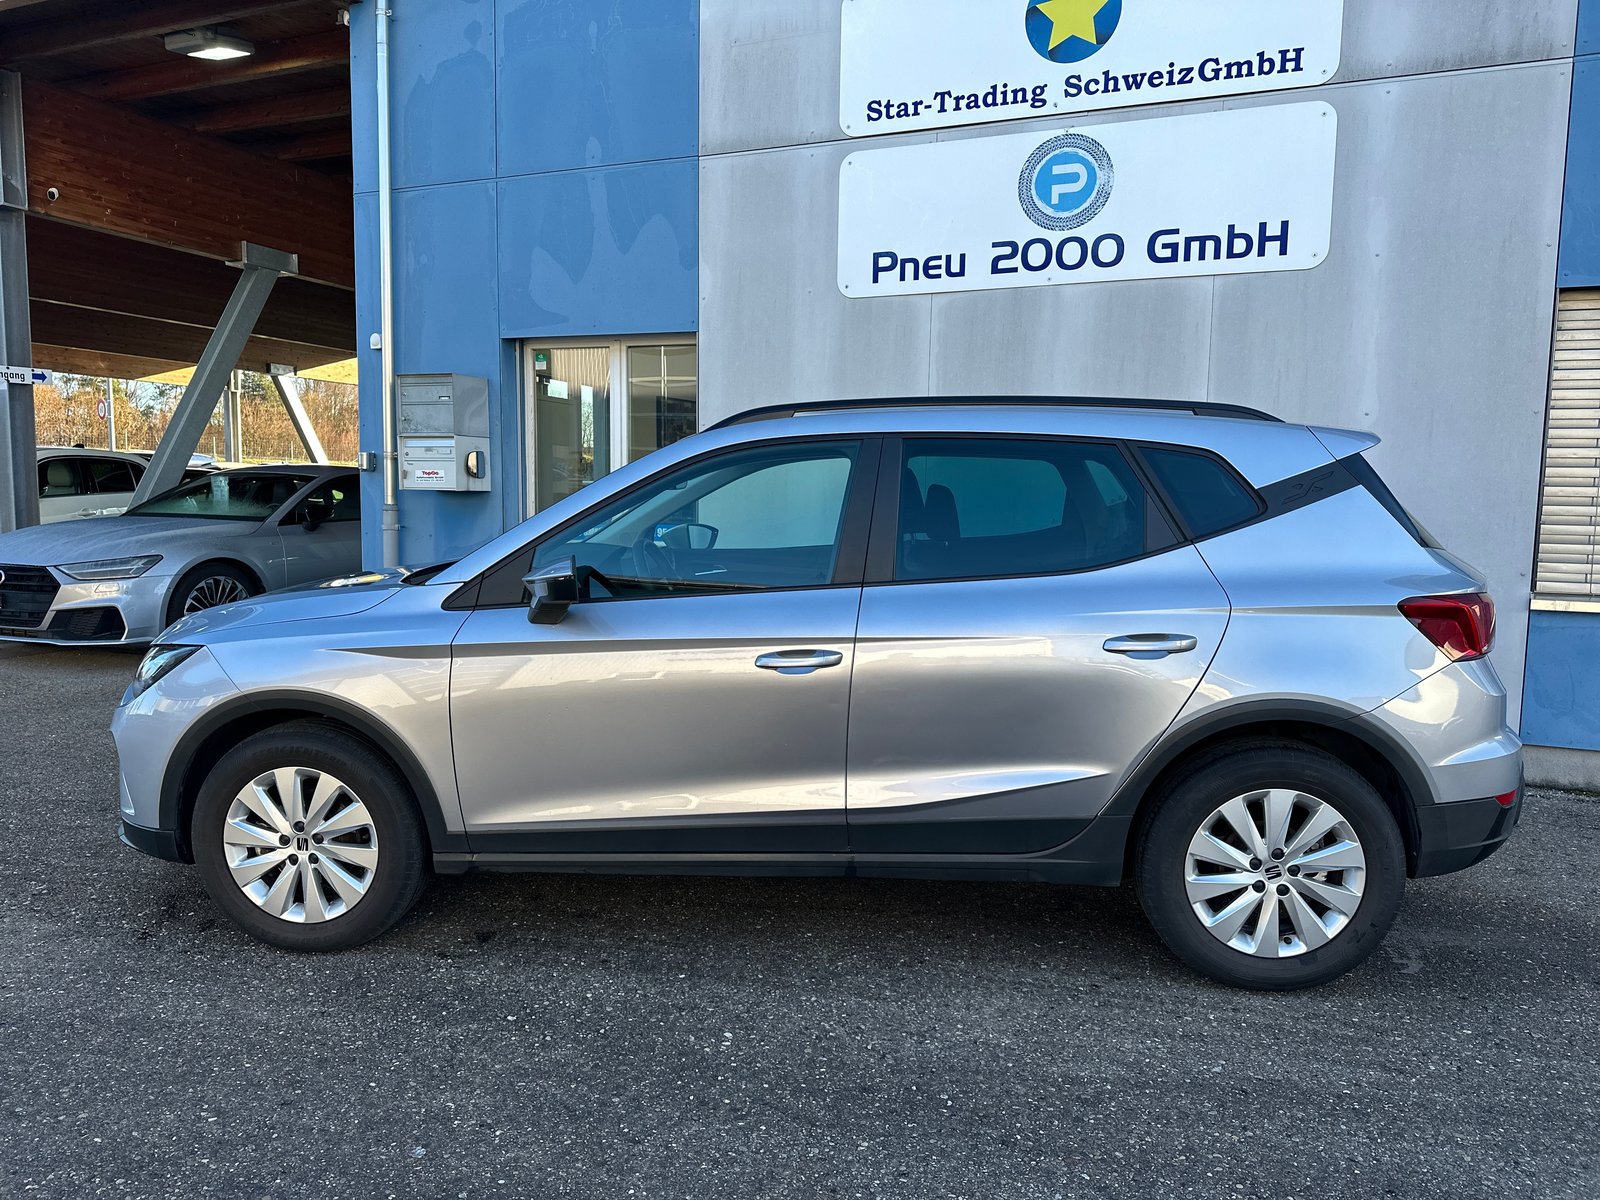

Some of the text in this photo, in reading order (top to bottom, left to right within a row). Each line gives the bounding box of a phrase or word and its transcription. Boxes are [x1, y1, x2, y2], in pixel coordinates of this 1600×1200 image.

[866, 82, 1048, 123] Star-Trading
[872, 219, 1290, 284] Pneu 2000 GmbH
